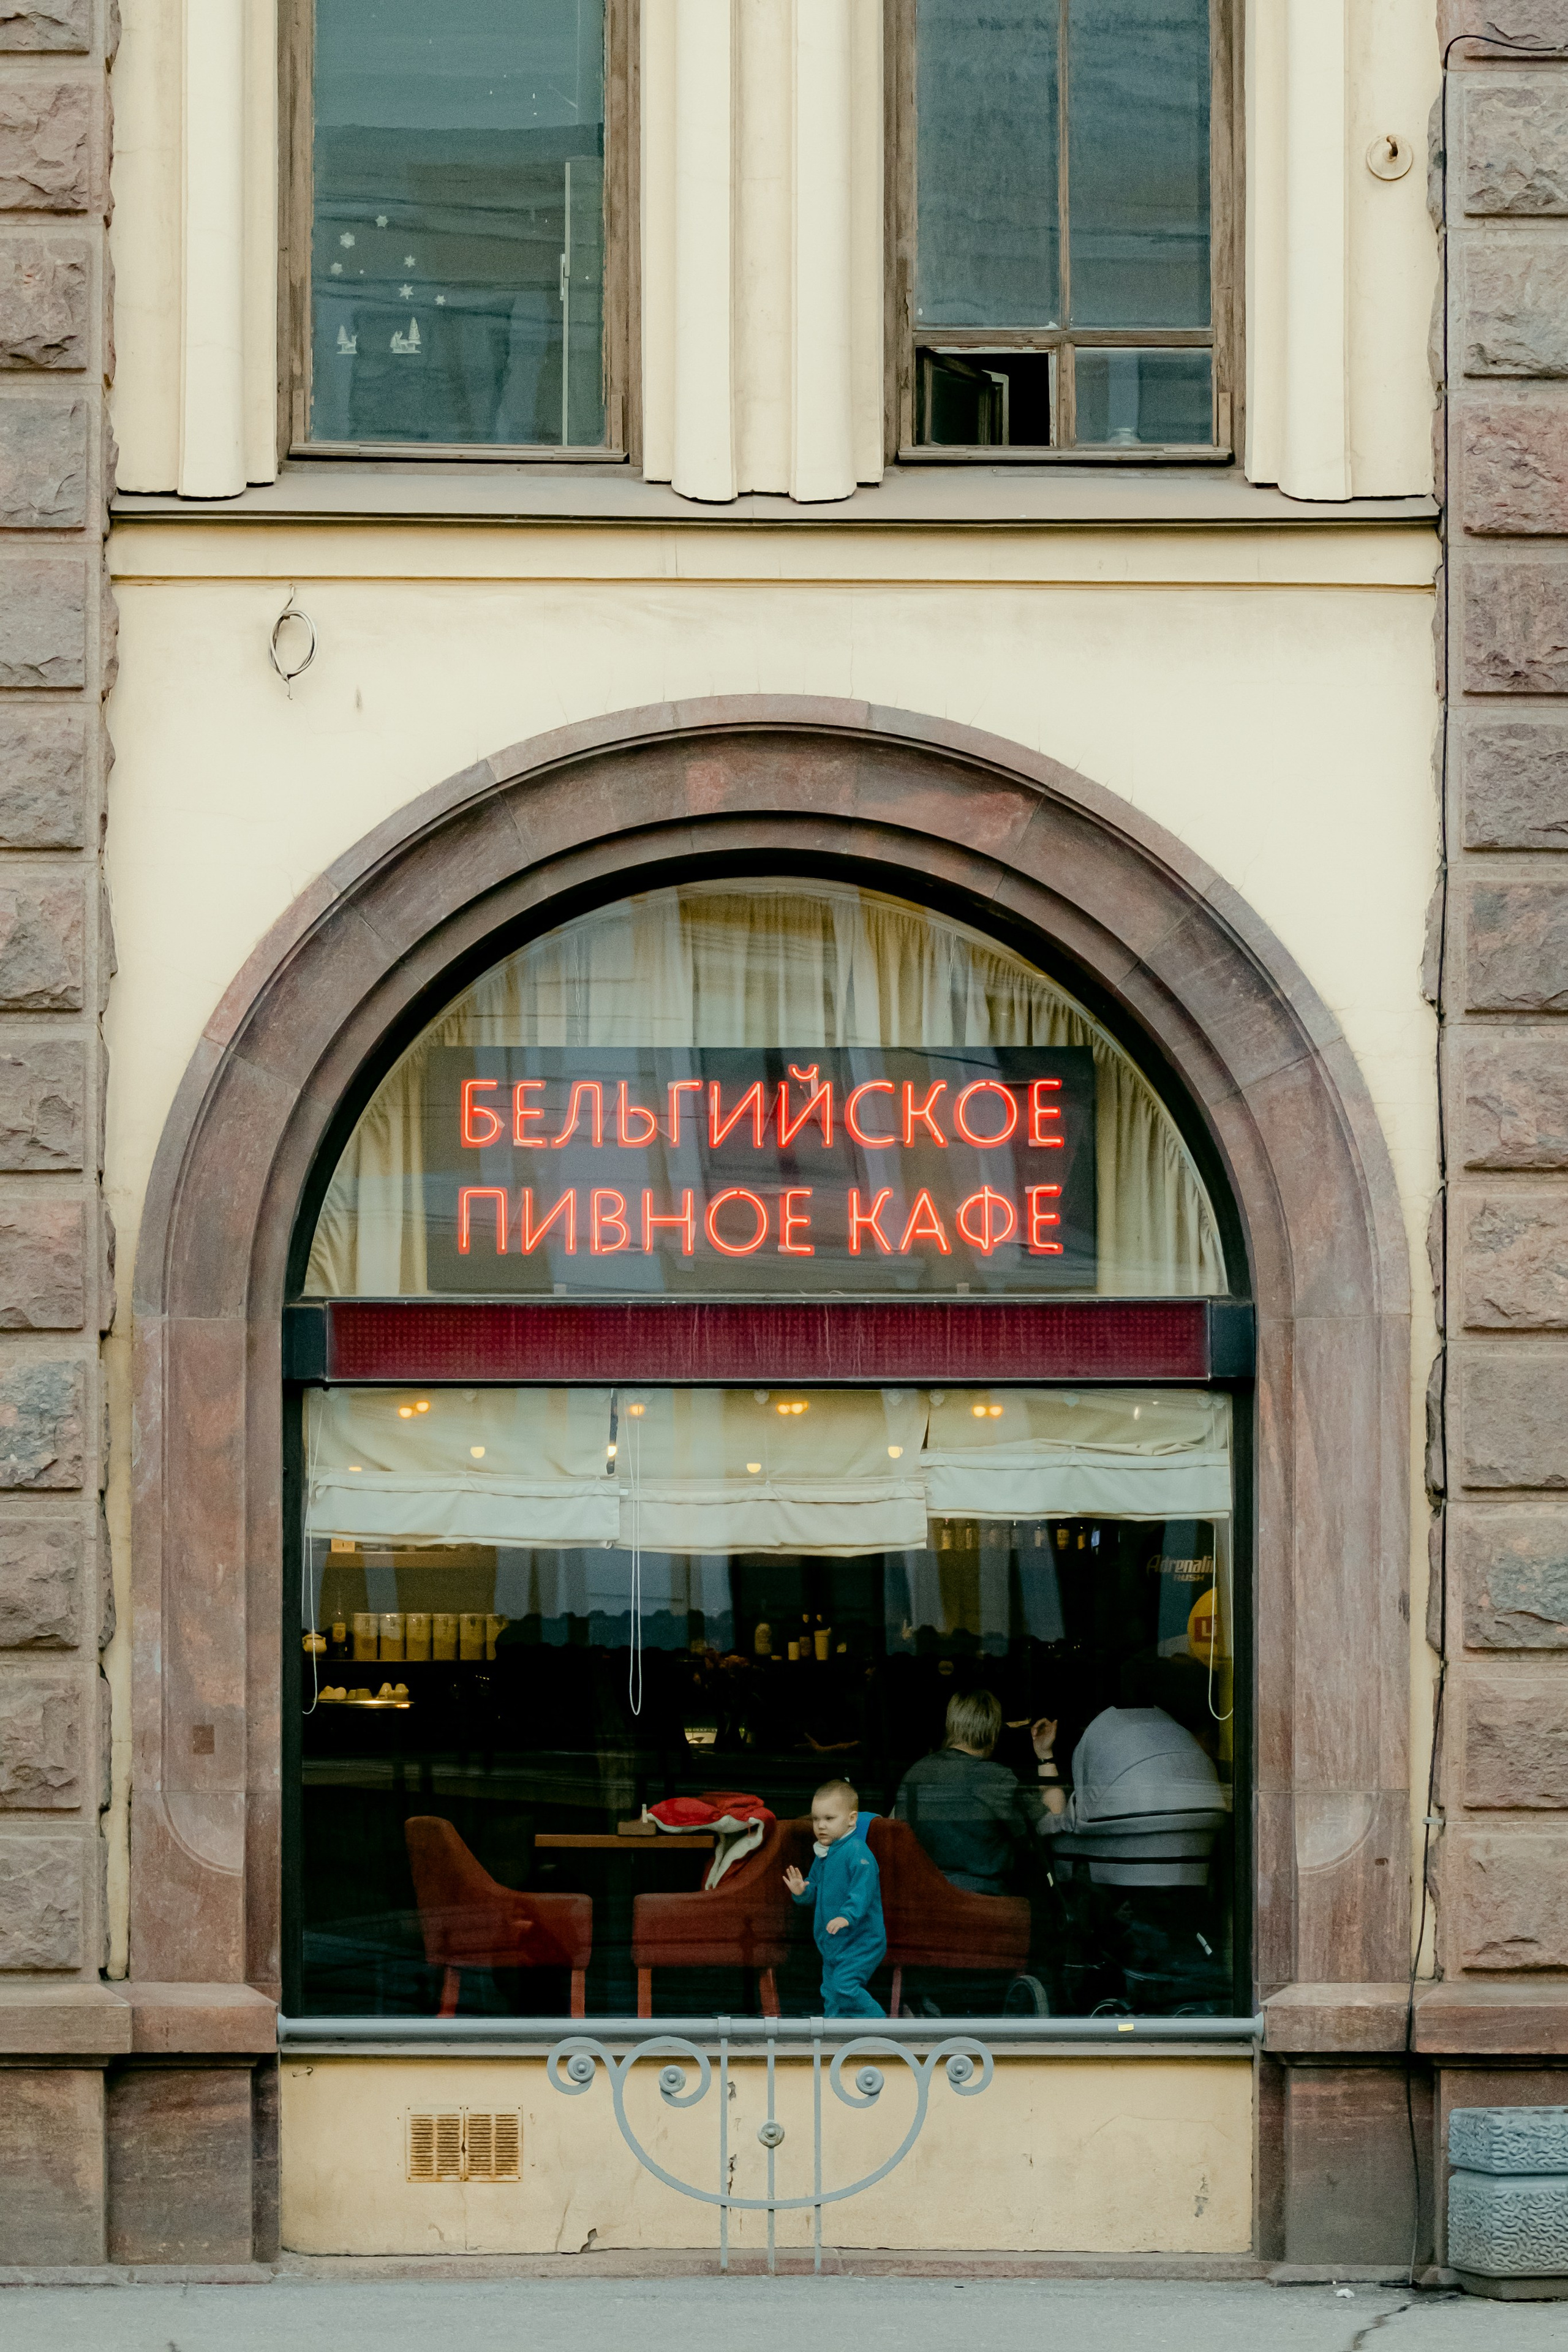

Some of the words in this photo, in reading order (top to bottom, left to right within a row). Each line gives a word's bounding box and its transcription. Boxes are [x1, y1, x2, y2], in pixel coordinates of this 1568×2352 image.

[460, 1065, 1065, 1148] БЕЛЬГИЙСКОЕ
[458, 1186, 815, 1256] ПИВНОЕ
[848, 1183, 1065, 1256] КАФЕ
